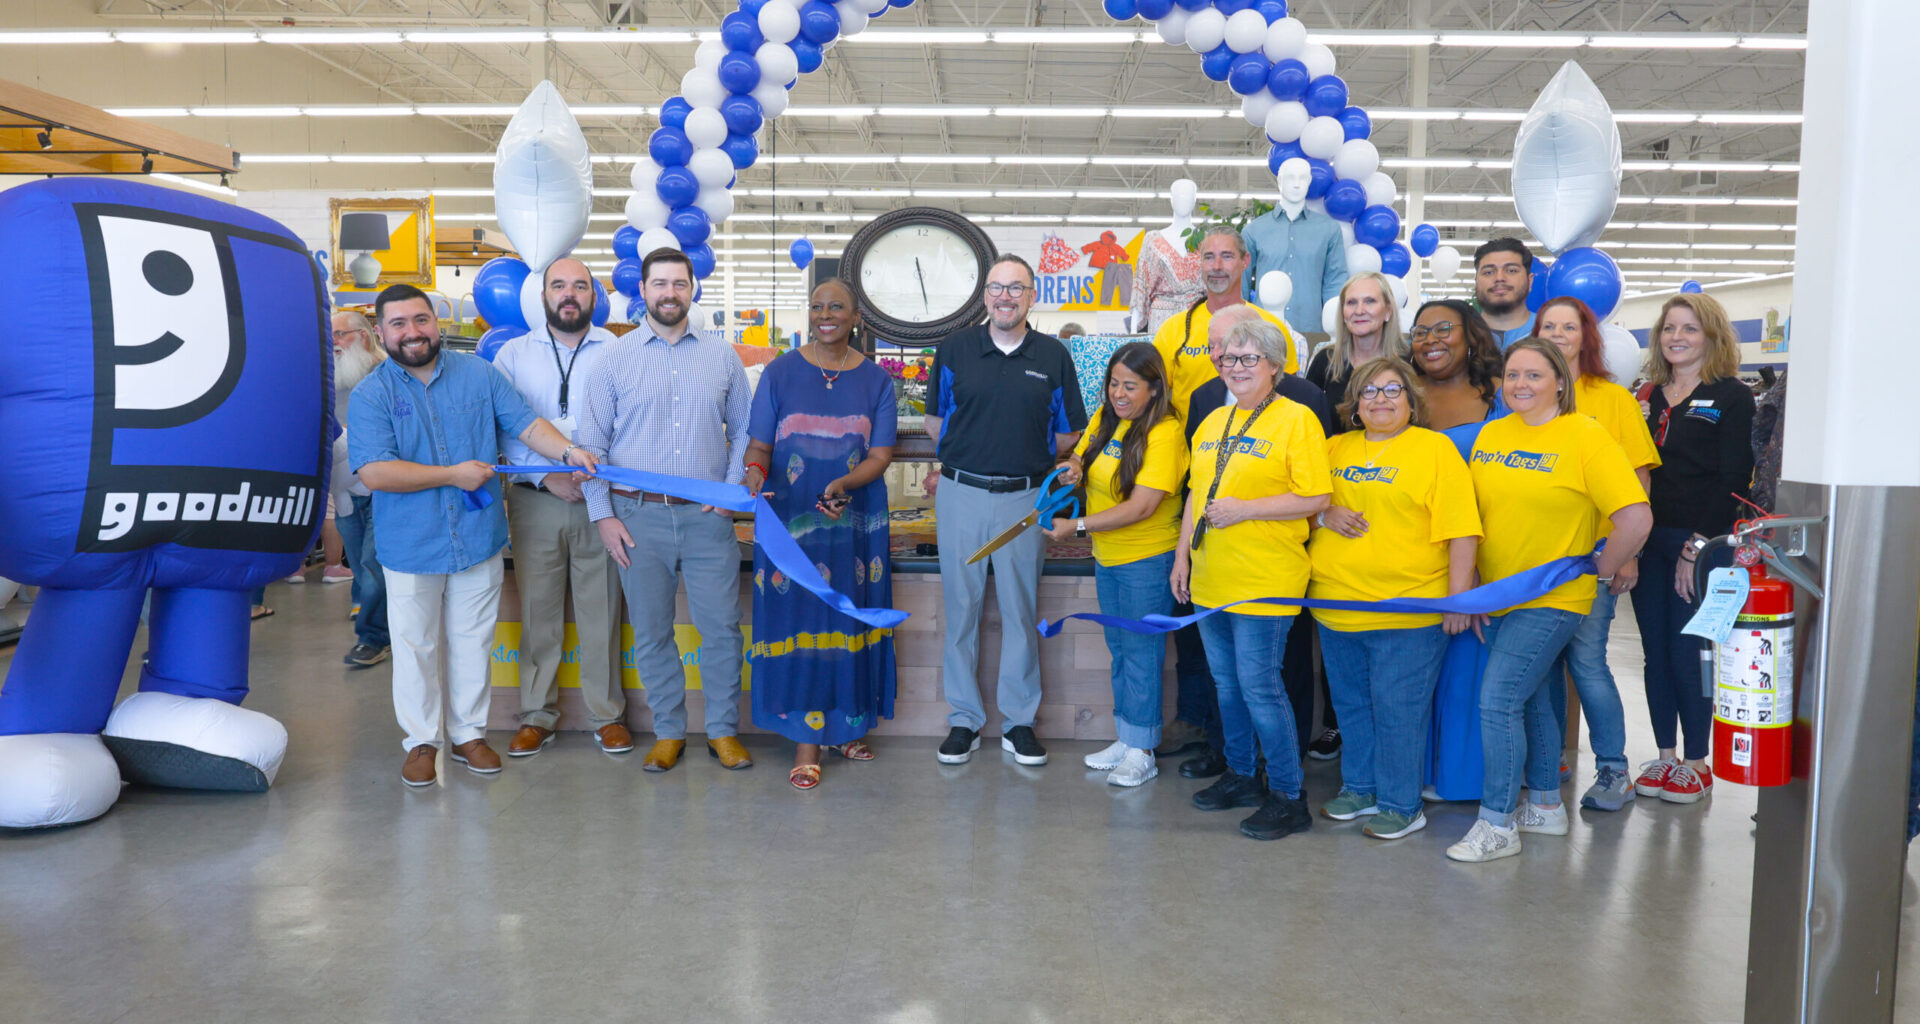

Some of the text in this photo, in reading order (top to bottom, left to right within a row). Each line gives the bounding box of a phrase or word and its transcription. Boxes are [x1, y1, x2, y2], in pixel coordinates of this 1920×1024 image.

[917, 228, 929, 237] 12
[1226, 438, 1252, 454] Tgs
[1472, 450, 1538, 468] Pop'n Tags
[1347, 467, 1377, 481] Tags
[97, 481, 315, 541] goodwill
